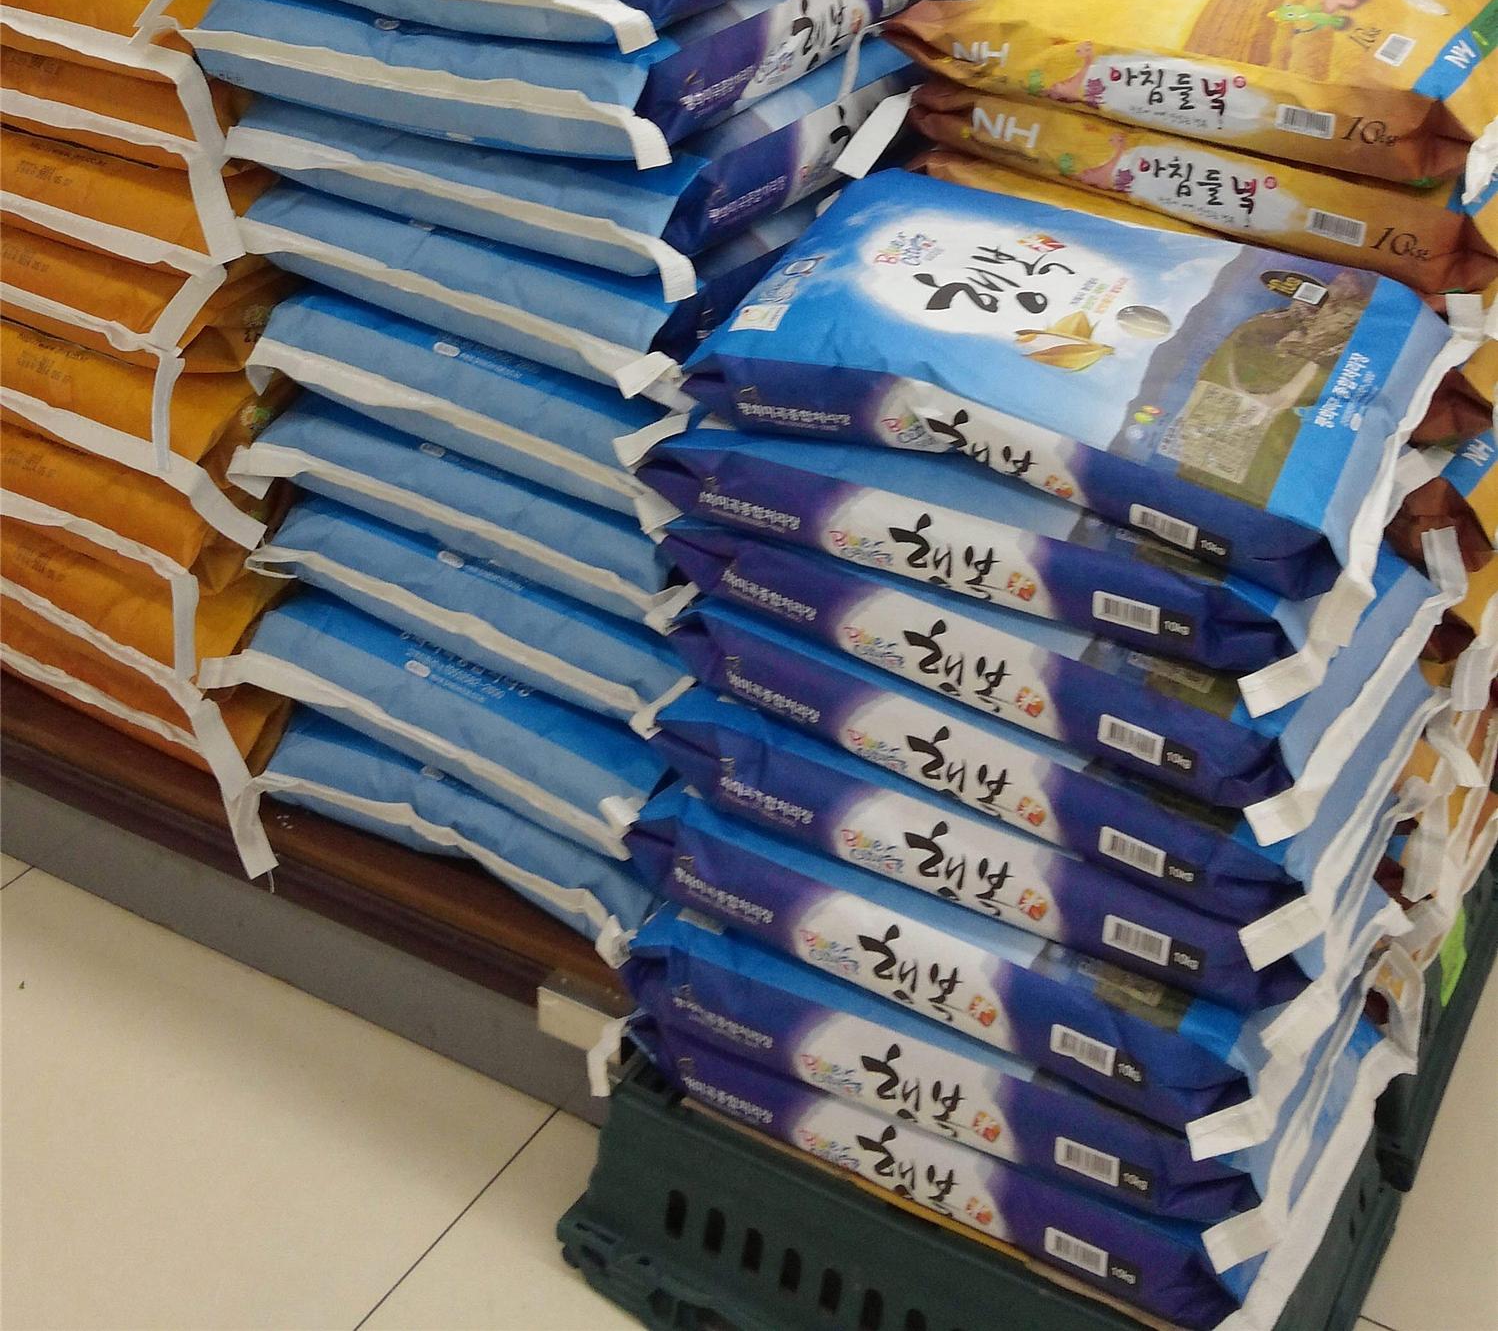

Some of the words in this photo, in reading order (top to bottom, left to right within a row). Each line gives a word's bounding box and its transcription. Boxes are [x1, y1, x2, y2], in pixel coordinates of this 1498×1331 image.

[952, 40, 1011, 68] NH
[1109, 63, 1227, 117] 아침들녘
[971, 106, 1041, 149] NH
[1341, 115, 1400, 147] 10kg
[1138, 156, 1256, 216] 아침들녘
[889, 513, 1000, 601] 행복
[903, 619, 1011, 713] 행복
[906, 725, 1011, 817] 행복
[904, 820, 1013, 916] 행복
[857, 924, 963, 1022] 행복
[860, 1043, 966, 1139] 행복
